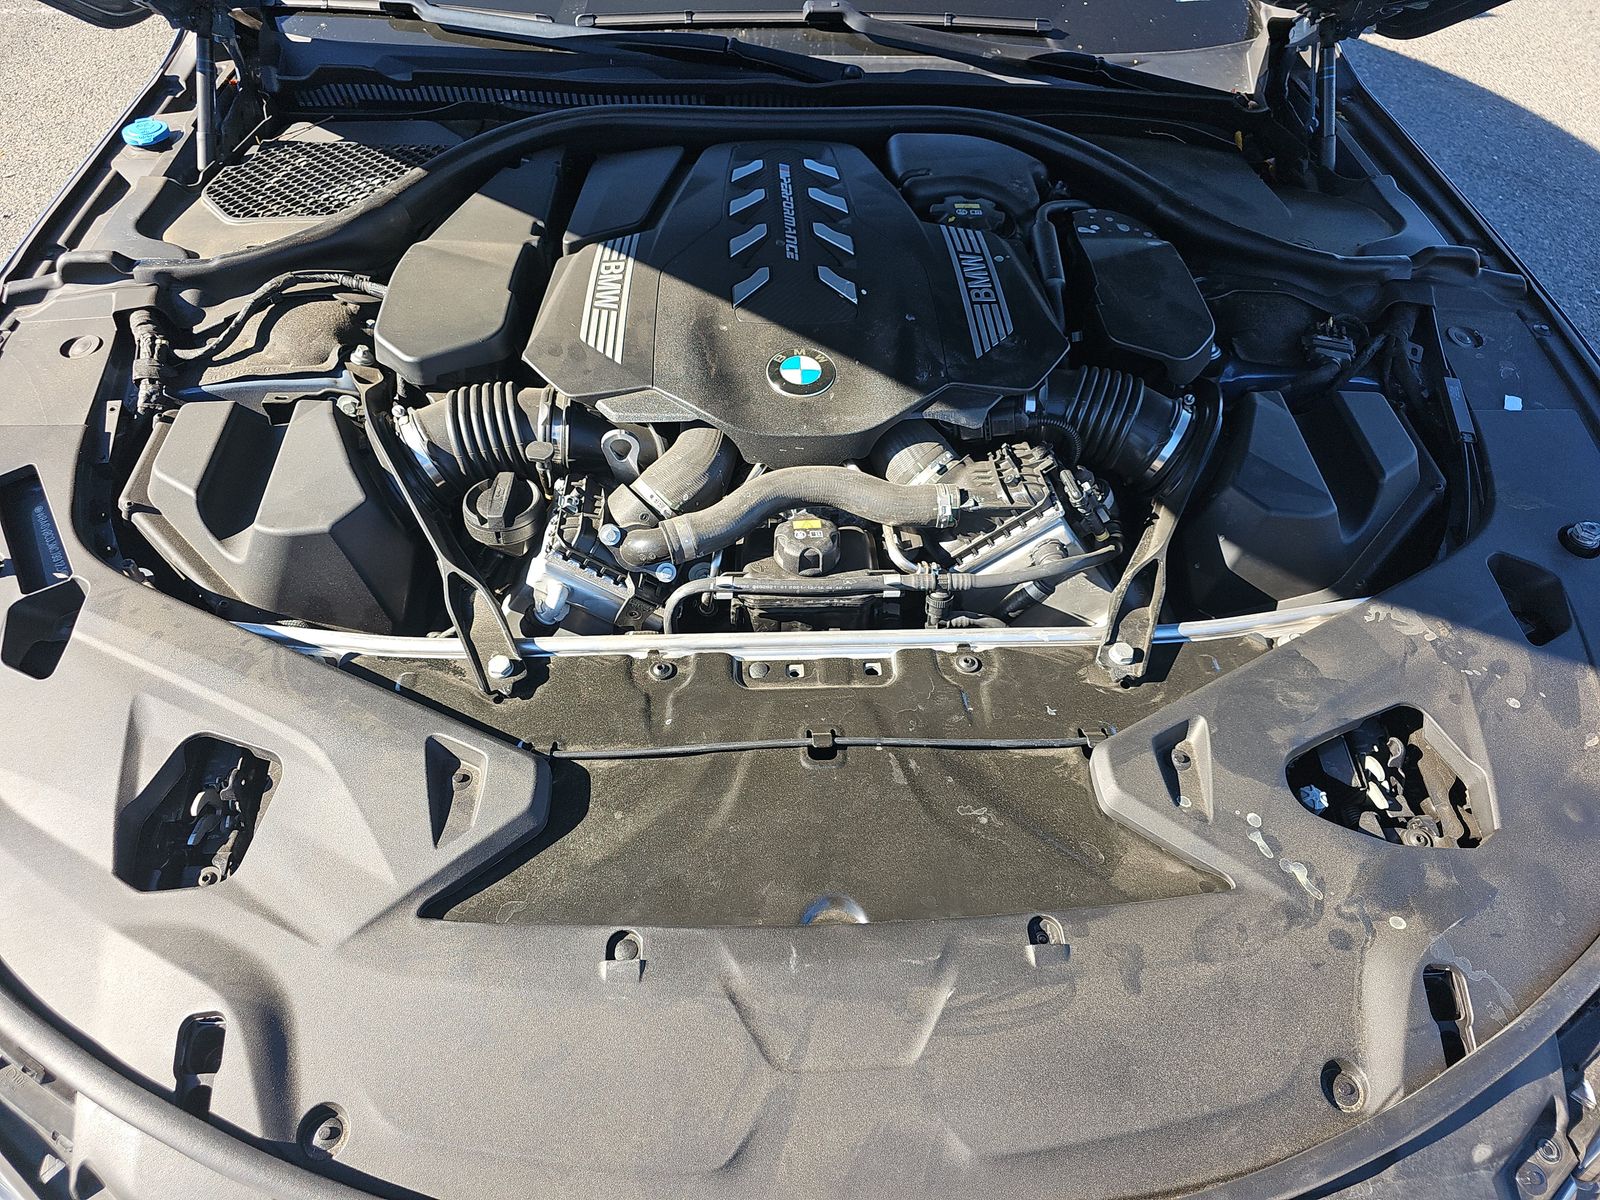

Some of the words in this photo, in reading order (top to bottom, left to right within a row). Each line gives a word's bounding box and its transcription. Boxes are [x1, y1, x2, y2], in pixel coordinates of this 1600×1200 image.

[779, 176, 799, 261] PERFORMANCE
[594, 261, 626, 310] BMW
[959, 254, 996, 302] BMW
[774, 348, 828, 364] BMW
